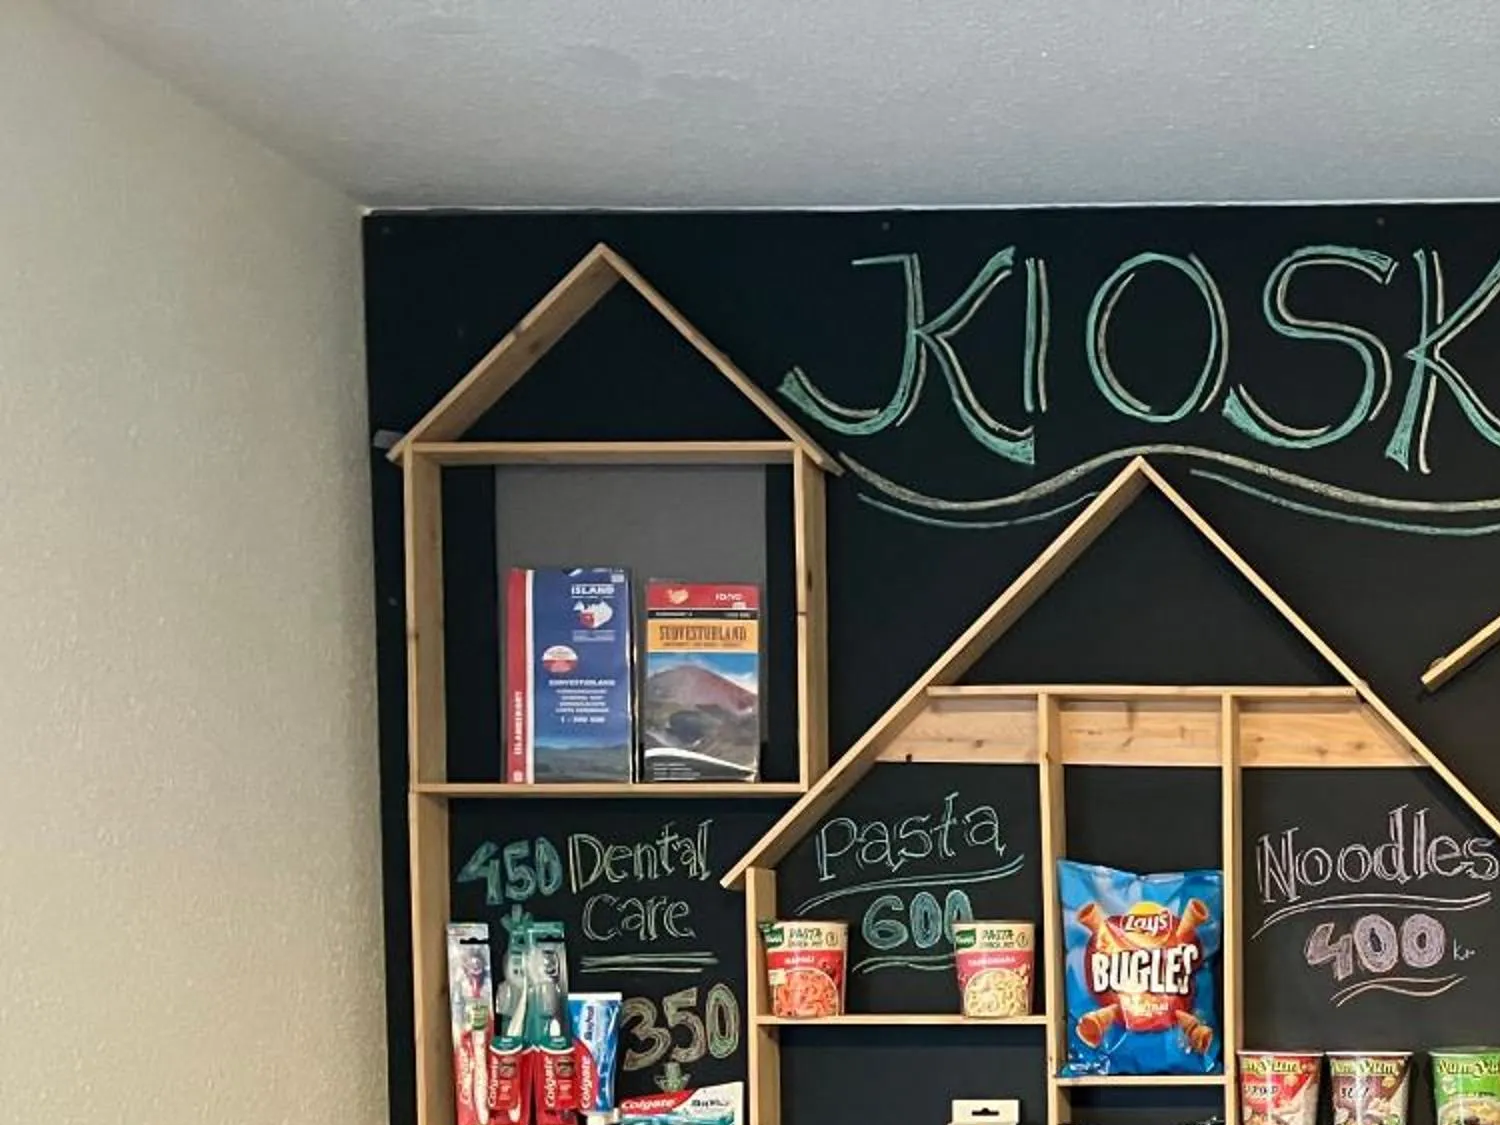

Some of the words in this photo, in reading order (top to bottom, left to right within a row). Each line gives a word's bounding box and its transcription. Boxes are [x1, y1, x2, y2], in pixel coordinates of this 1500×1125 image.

[456, 836, 563, 906] 450
[567, 818, 713, 894] Dental
[815, 791, 1007, 882] Pasta
[1256, 803, 1500, 906] Noodles
[581, 893, 697, 942] Care
[862, 889, 975, 951] 600
[1304, 913, 1447, 981] 400
[1090, 943, 1199, 995] BUGLES
[620, 982, 741, 1072] 350
[488, 1053, 501, 1109] Colgate
[544, 1051, 556, 1109] Colgate
[581, 1056, 593, 1110] Colgate
[620, 1096, 677, 1113] Colgate
